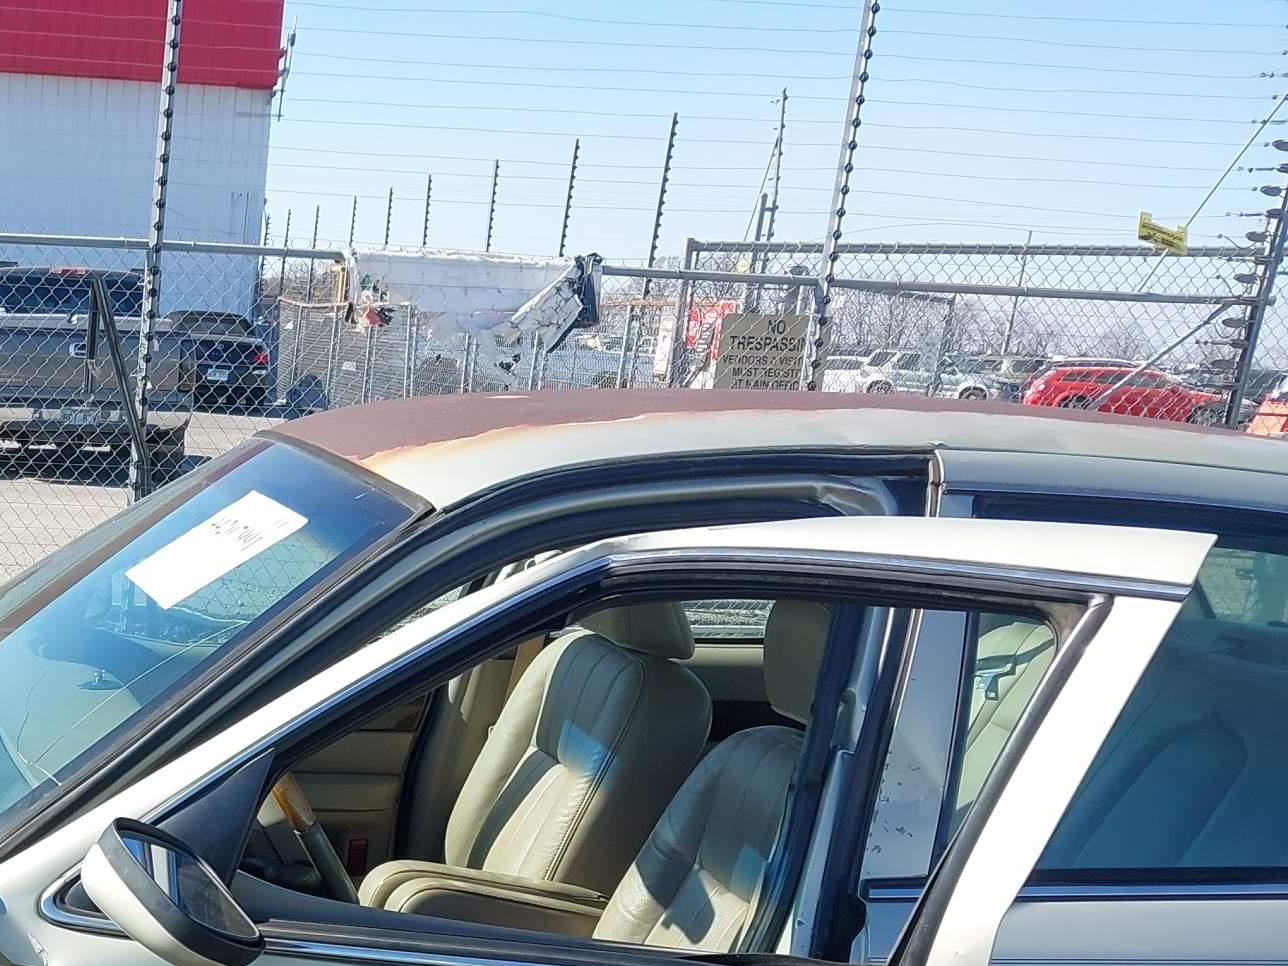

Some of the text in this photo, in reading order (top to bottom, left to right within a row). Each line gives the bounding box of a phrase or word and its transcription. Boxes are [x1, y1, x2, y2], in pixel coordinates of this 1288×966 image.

[767, 319, 786, 334] NO
[729, 335, 806, 352] TRESPASSIN
[722, 354, 768, 366] VENDORS
[779, 356, 803, 366] VISIT
[732, 367, 801, 378] MUST REGIST
[772, 380, 800, 391] OFFIC
